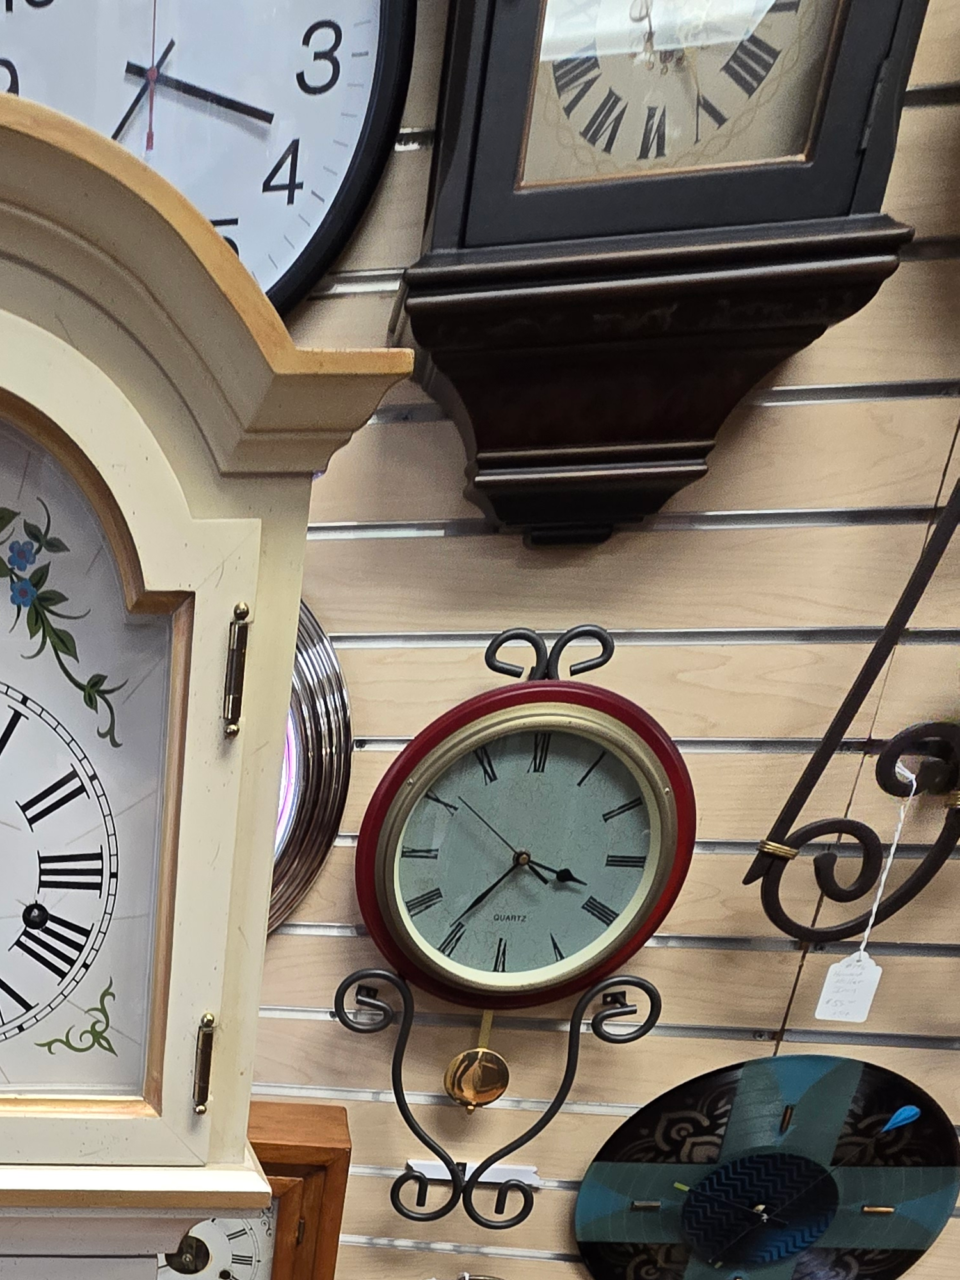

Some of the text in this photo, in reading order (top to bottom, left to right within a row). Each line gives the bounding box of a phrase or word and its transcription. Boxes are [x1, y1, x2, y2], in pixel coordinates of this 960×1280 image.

[296, 19, 343, 95] 3
[580, 87, 628, 154] VII
[637, 104, 666, 161] VI
[262, 138, 304, 205] 4
[473, 745, 498, 786] XI
[527, 733, 551, 774] XII
[577, 750, 606, 787] I
[15, 763, 90, 832] II
[425, 789, 459, 816] X
[602, 796, 644, 823] II
[401, 845, 439, 860] IX
[605, 854, 647, 869] III
[37, 845, 103, 899] III
[404, 888, 443, 918] VIII
[493, 913, 527, 923] QUARTZ
[581, 895, 620, 927] IIII
[8, 908, 94, 986] IIII
[438, 922, 466, 957] VII
[492, 937, 507, 973] VI
[550, 932, 566, 962] V
[226, 1228, 249, 1243] II
[231, 1254, 254, 1266] III
